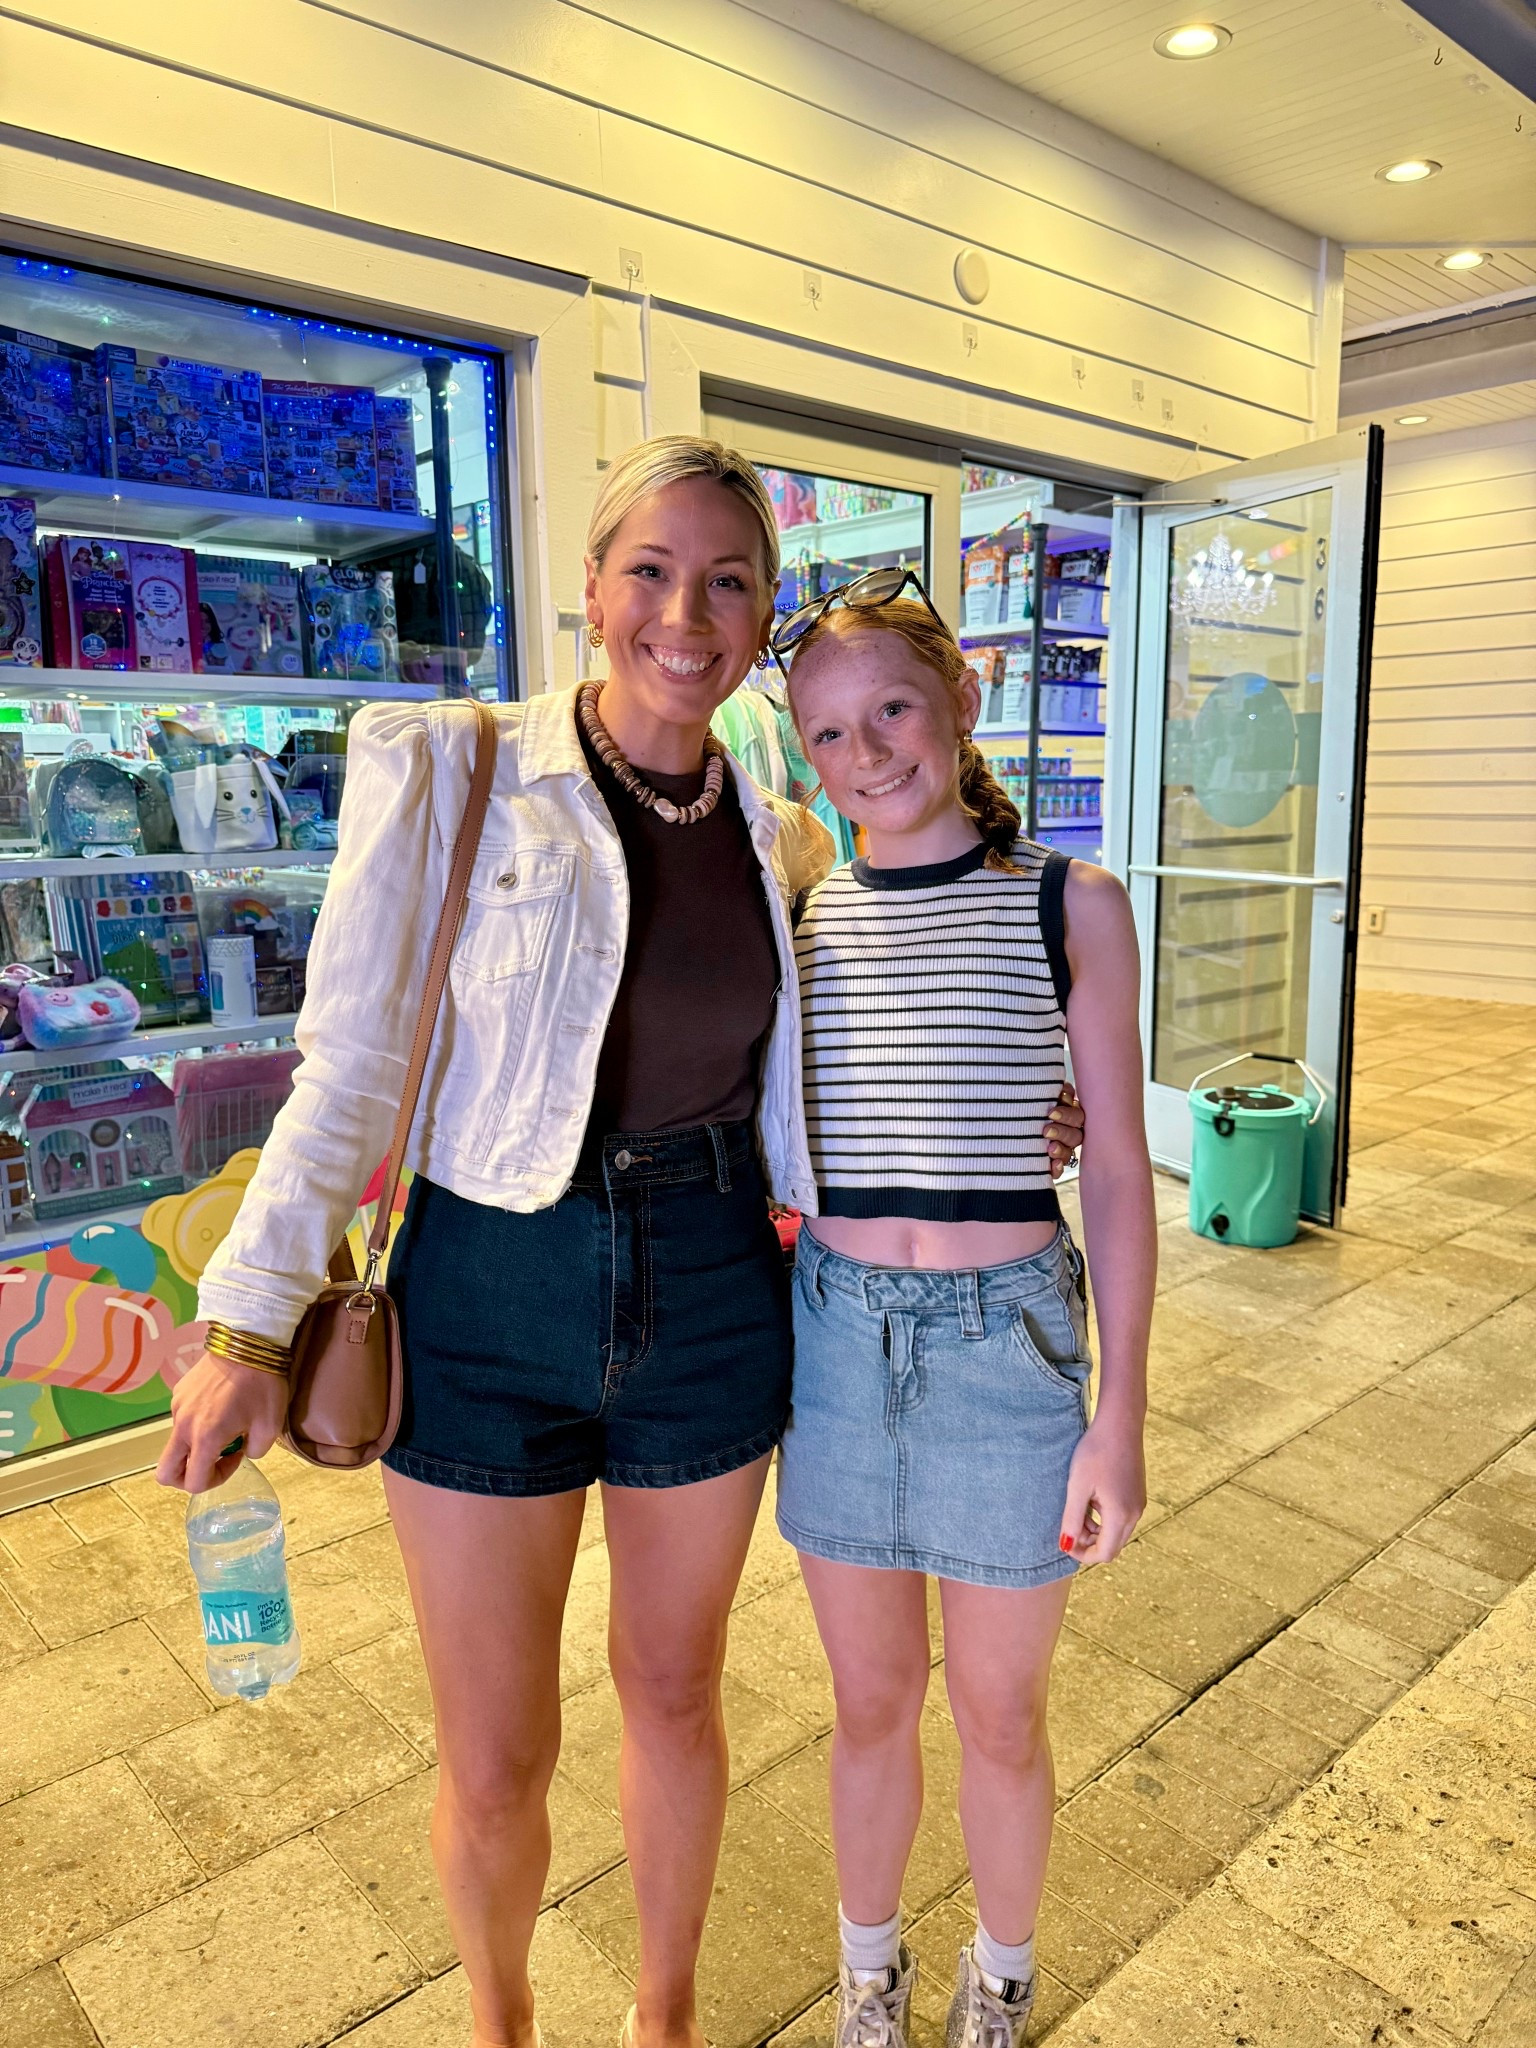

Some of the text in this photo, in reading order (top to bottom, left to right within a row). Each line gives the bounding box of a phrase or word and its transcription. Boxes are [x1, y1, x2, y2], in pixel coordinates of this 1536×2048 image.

[195, 364, 223, 376] Florida
[198, 575, 215, 584] ake
[333, 568, 364, 581] GLOW
[73, 1087, 101, 1098] make
[103, 1084, 108, 1093] it
[109, 1080, 127, 1091] real
[202, 1604, 252, 1640] ANI
